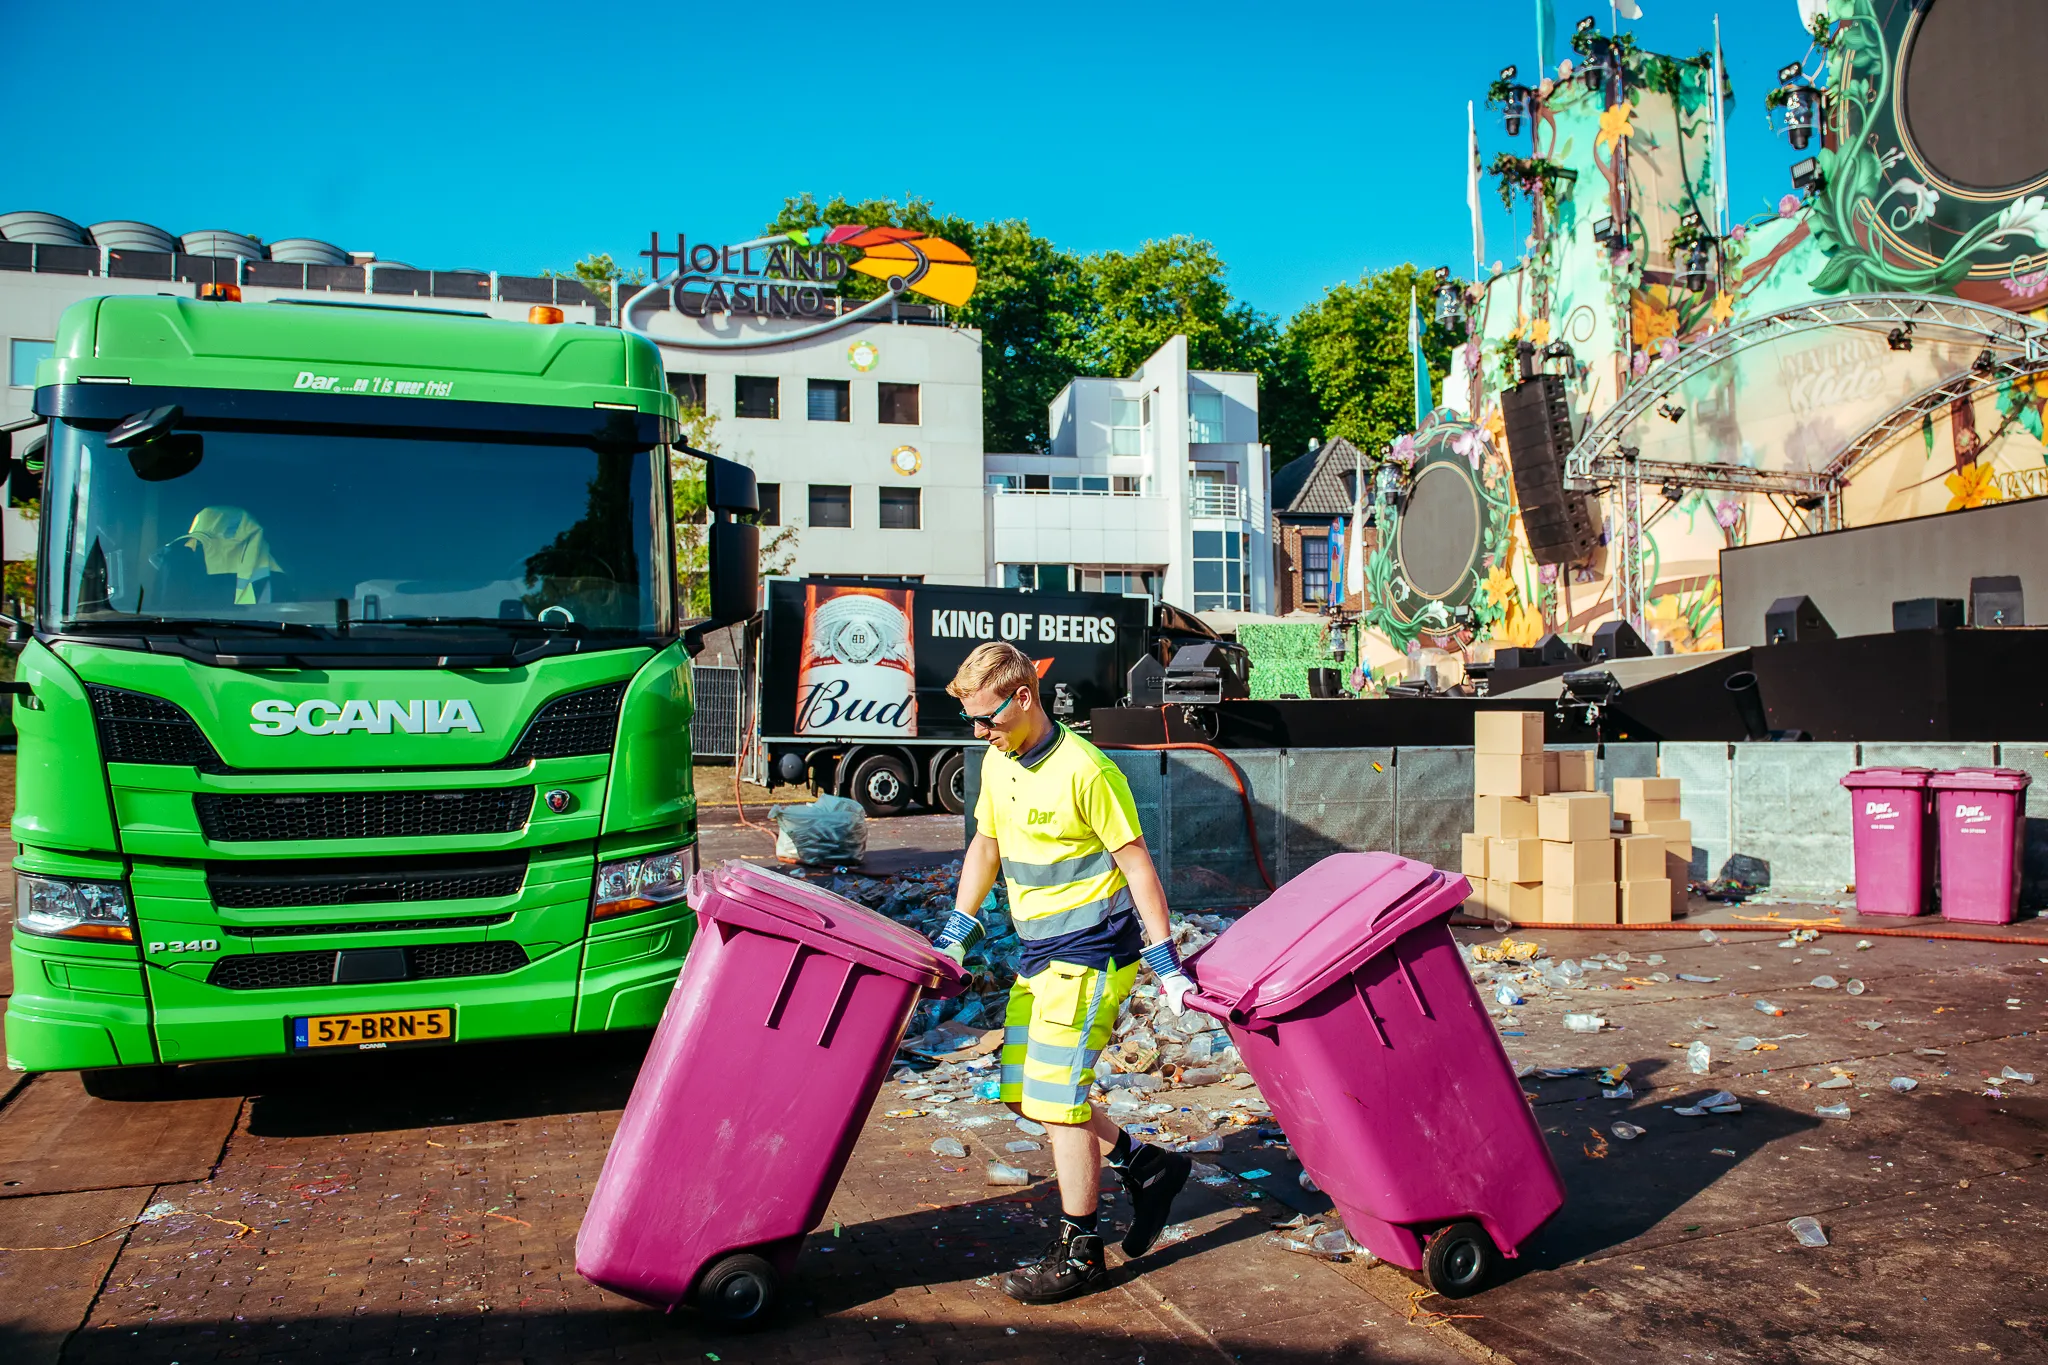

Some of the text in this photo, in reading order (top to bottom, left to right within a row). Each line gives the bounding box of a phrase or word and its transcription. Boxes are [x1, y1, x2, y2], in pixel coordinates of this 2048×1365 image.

[640, 231, 847, 282] HOLLAND
[673, 275, 824, 318] CASINO
[380, 378, 394, 394] is
[394, 379, 425, 395] weer
[424, 380, 454, 397] fris!
[931, 609, 994, 640] KING
[1000, 612, 1034, 641] OF
[1038, 614, 1116, 645] BEERS
[249, 698, 485, 736] SCANIA
[796, 679, 914, 734] Bud
[295, 1035, 307, 1043] NL
[318, 1013, 443, 1042] 57-BRN-5
[359, 1042, 387, 1050] SCANIA
